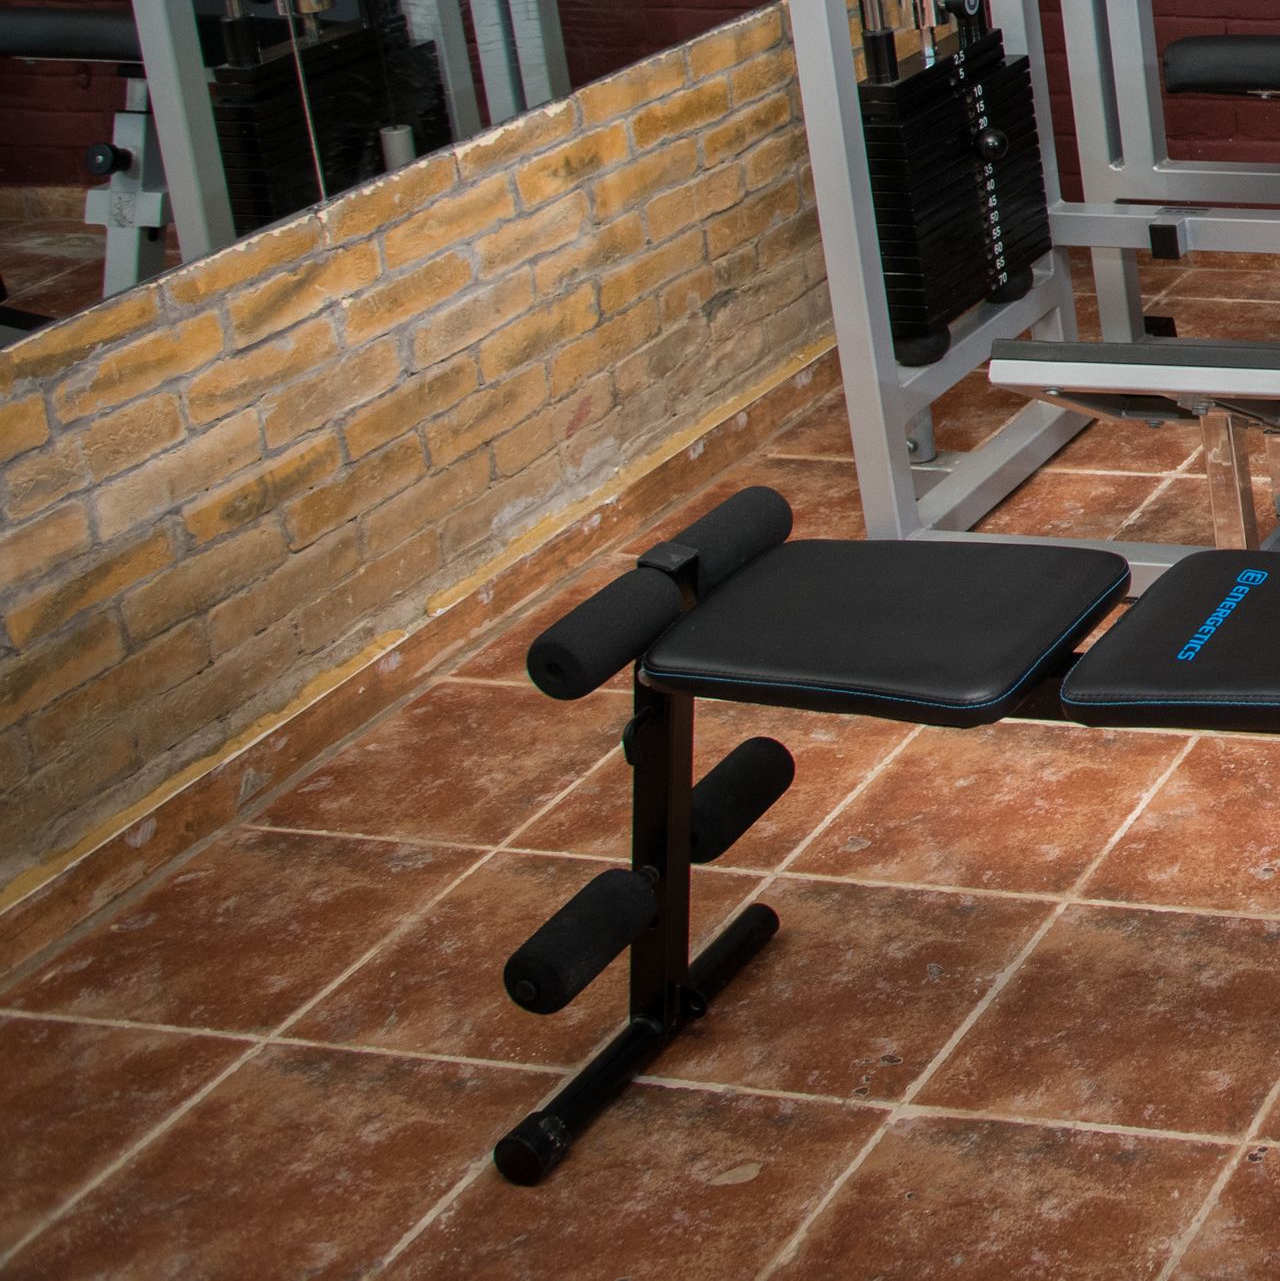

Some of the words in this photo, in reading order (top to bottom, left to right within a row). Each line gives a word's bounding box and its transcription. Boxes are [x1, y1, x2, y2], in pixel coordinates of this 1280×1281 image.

[953, 50, 965, 65] 2,5
[958, 68, 965, 79] 5
[973, 84, 983, 98] 10
[976, 100, 985, 113] 15
[978, 116, 988, 130] 20
[984, 163, 993, 176] 35
[988, 194, 997, 207] 45
[990, 210, 999, 224] 50
[992, 226, 1001, 239] 55
[996, 256, 1005, 269] 65
[998, 272, 1008, 285] 70
[1177, 585, 1251, 661] ENERGETICS
